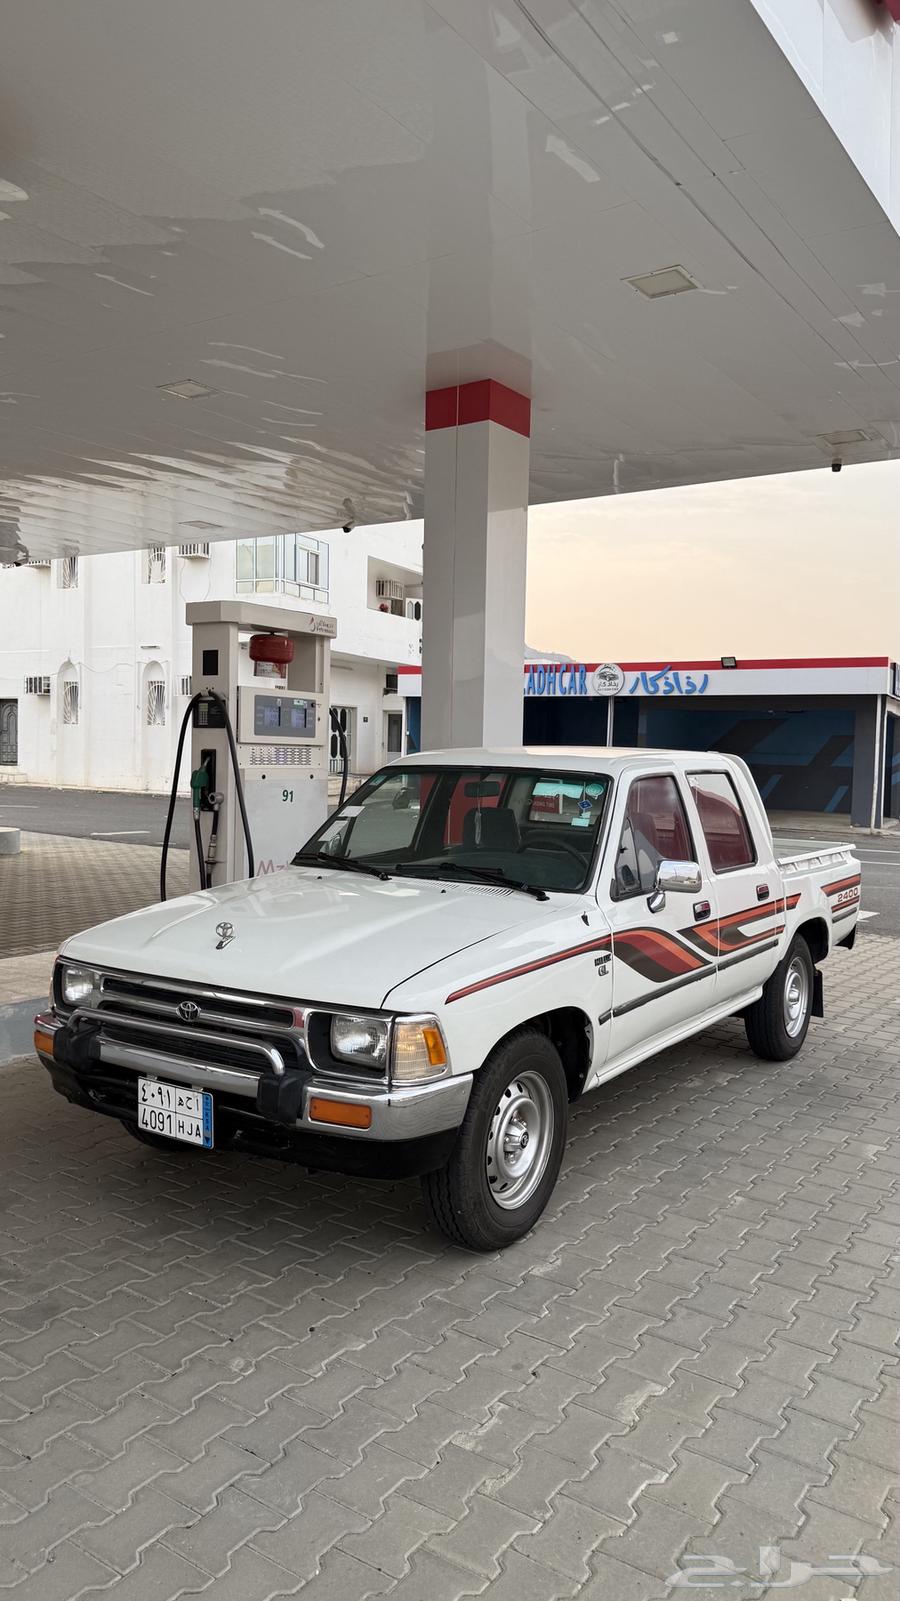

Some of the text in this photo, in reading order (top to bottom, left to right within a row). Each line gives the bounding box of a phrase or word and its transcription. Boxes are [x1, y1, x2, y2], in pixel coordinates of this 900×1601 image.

[523, 664, 588, 695] ADHCAR
[282, 789, 294, 803] 91
[837, 887, 858, 902] 2400
[141, 1107, 202, 1138] 4091 HJA
